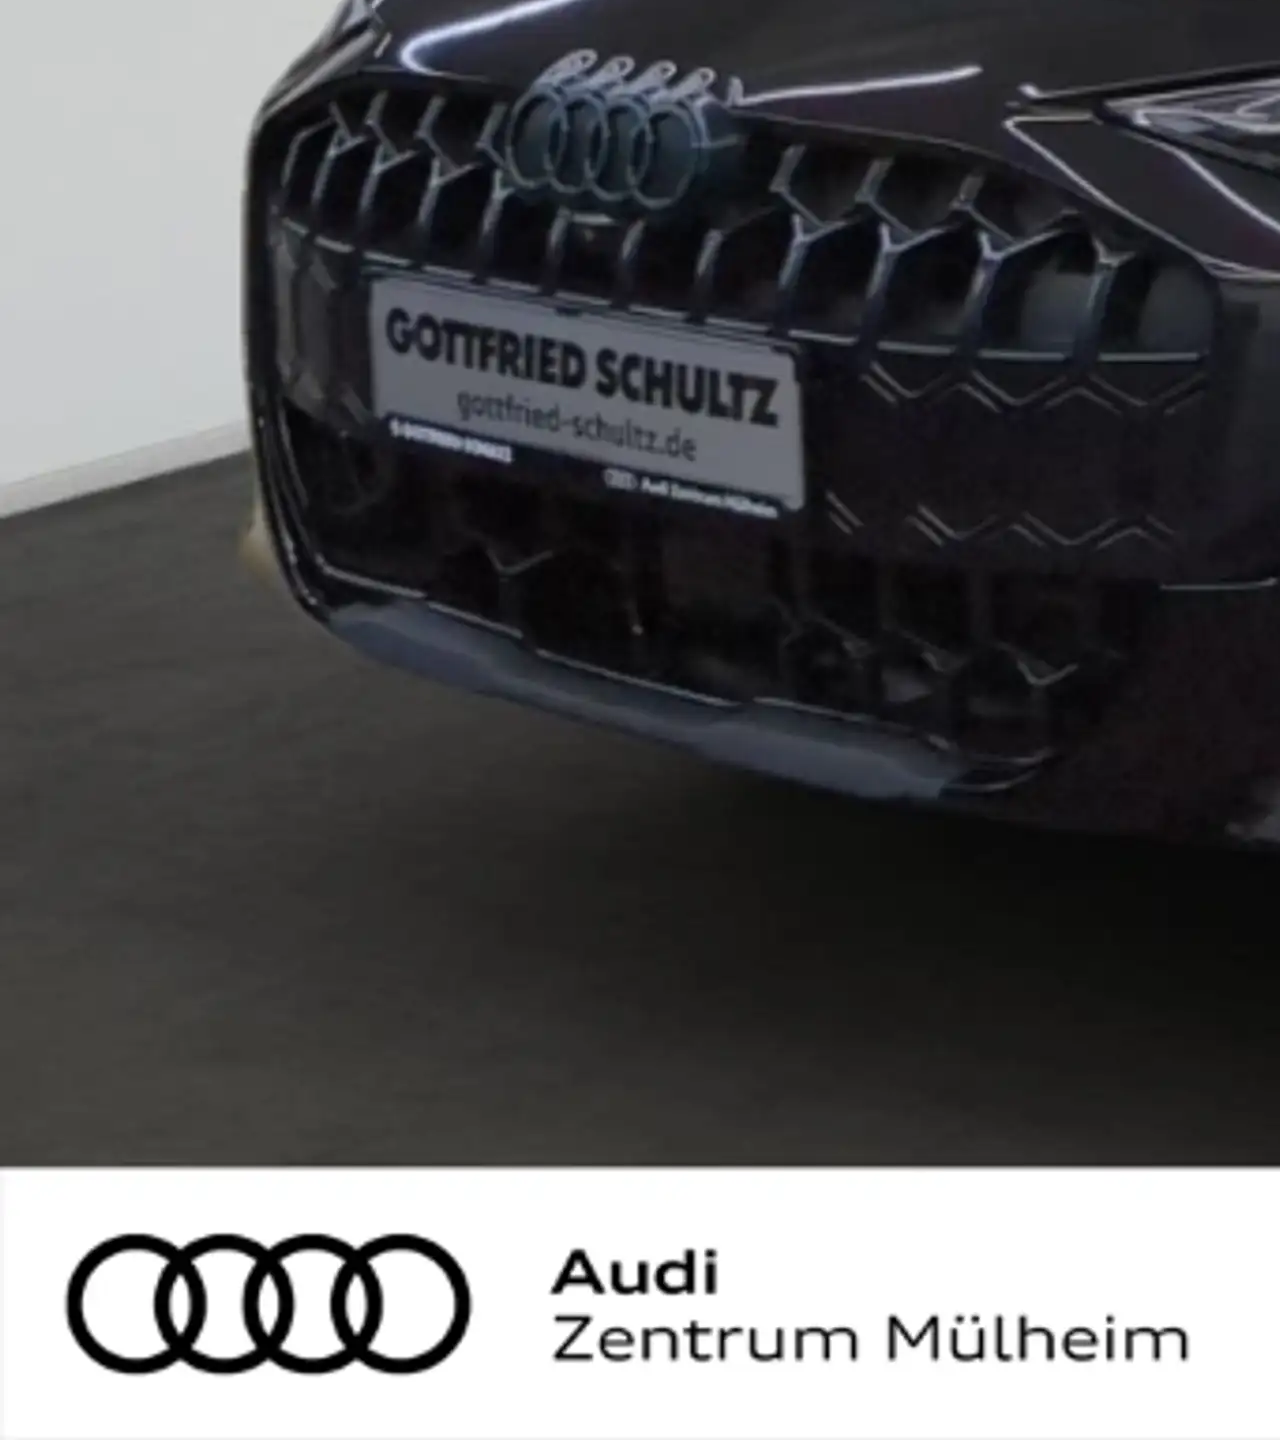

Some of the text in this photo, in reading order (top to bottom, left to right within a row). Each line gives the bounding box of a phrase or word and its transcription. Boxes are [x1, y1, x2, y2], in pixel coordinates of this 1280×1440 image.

[385, 307, 781, 428] GOTTFRIED SCHULTZ
[456, 390, 697, 463] gottfried-schultz.de
